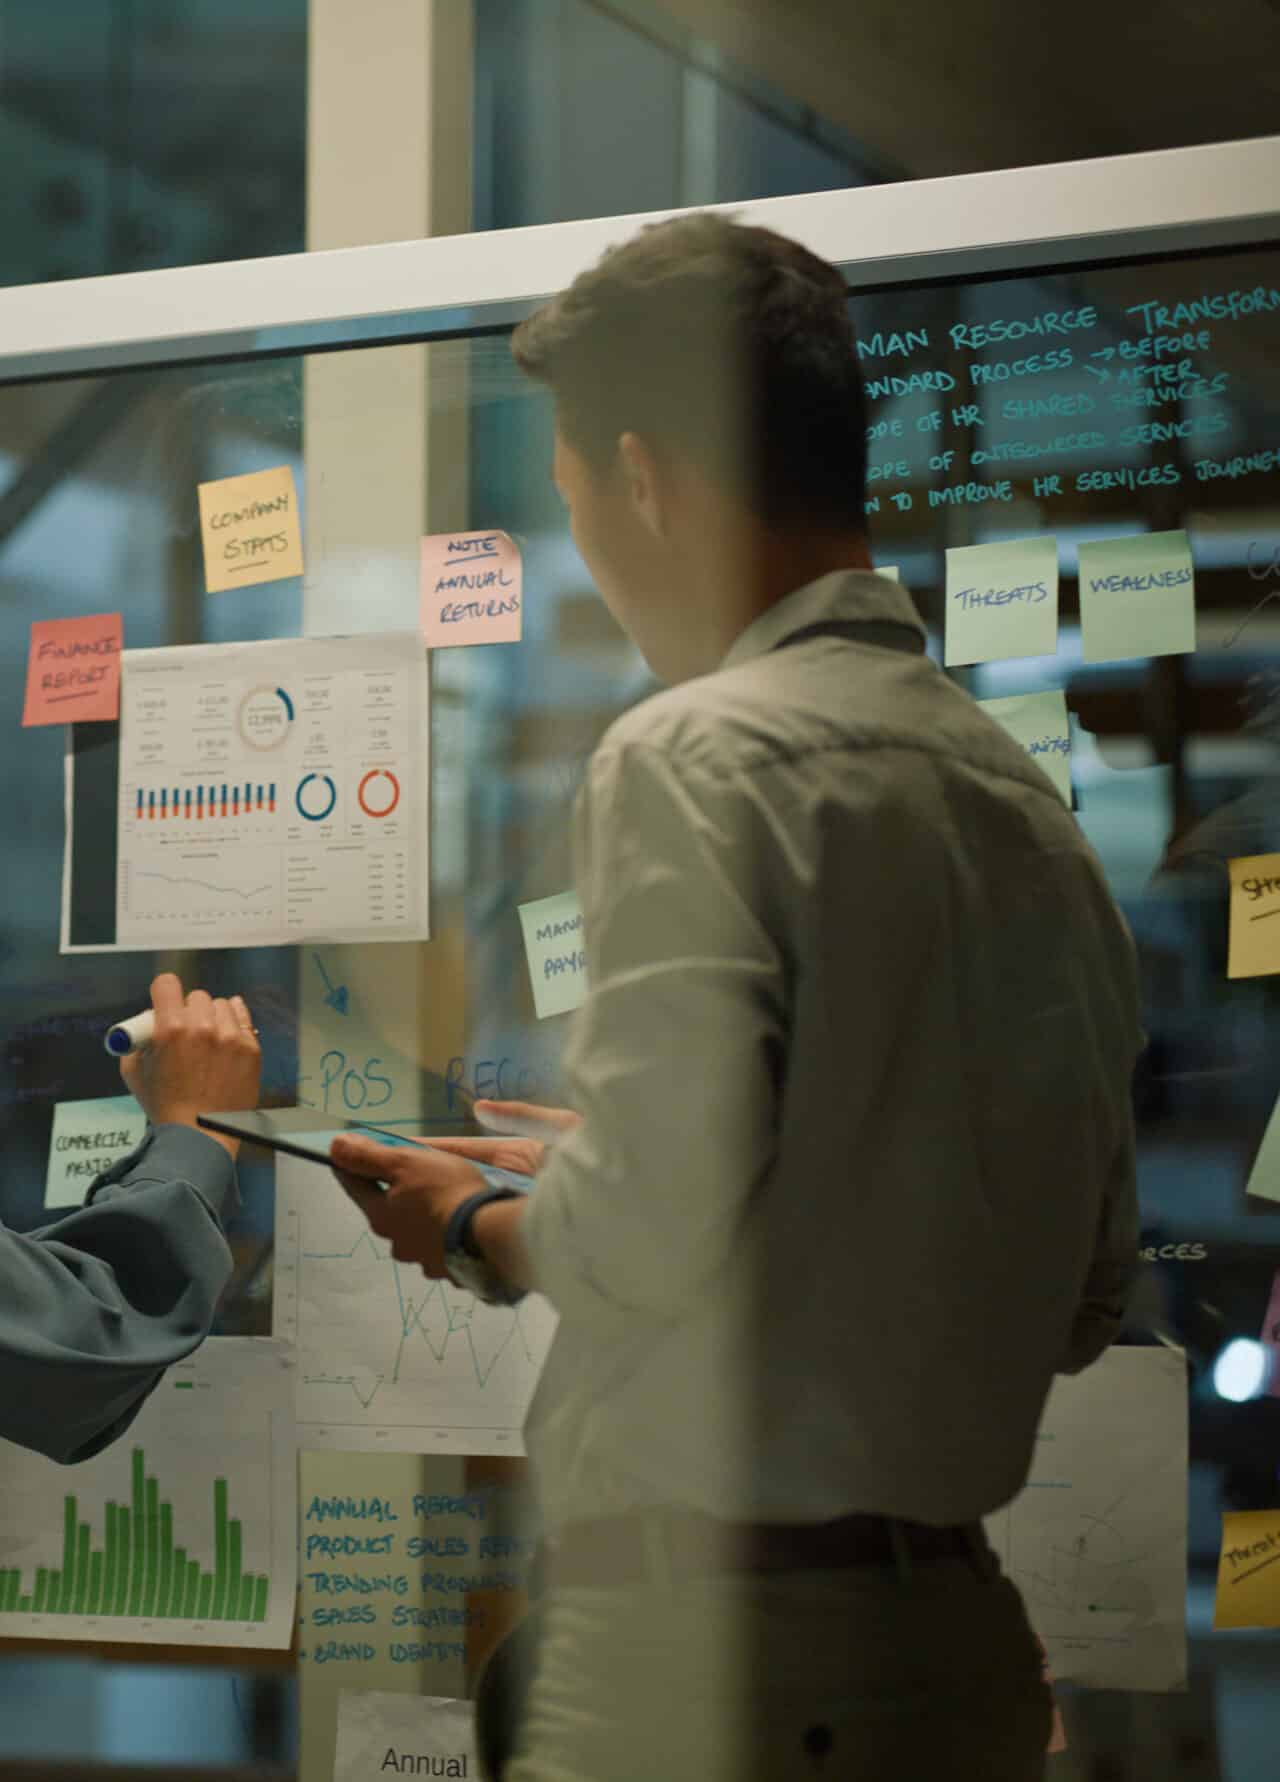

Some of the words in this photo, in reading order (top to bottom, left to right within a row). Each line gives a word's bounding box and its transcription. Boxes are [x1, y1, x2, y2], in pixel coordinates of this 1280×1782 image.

[949, 306, 1097, 350] RESOURCE
[970, 349, 1074, 384] PROCESS
[1119, 330, 1211, 360] BEFORE
[1117, 358, 1200, 386] AFTER
[914, 411, 942, 432] OF
[951, 404, 984, 427] HR
[1002, 391, 1096, 420] SHARED
[1113, 372, 1230, 411] SERVICES
[928, 450, 956, 471] OF
[1120, 413, 1230, 447] SERVICES
[890, 492, 913, 511] TO
[928, 480, 1012, 507] IMPROVE
[1032, 474, 1063, 497] HR
[1075, 464, 1180, 492] SERVICES
[209, 495, 288, 531] COMPANY
[223, 531, 288, 561] STATS
[446, 536, 497, 552] NOTE
[434, 567, 513, 594] ANNUAL
[1089, 567, 1193, 593] WEAKNESS
[439, 594, 520, 624] RETURNS
[954, 581, 1049, 611] THREATS
[40, 664, 112, 691] REPORT
[320, 1050, 393, 1112] POS
[1138, 1242, 1209, 1262] RCES
[306, 1496, 399, 1522] ANNUAL
[305, 1533, 396, 1560] PRODUCT
[406, 1536, 470, 1559] SALES
[305, 1572, 408, 1596] TRENDING
[311, 1604, 377, 1626] SALES
[313, 1640, 377, 1664] BRAND
[380, 1747, 468, 1779] Annual
